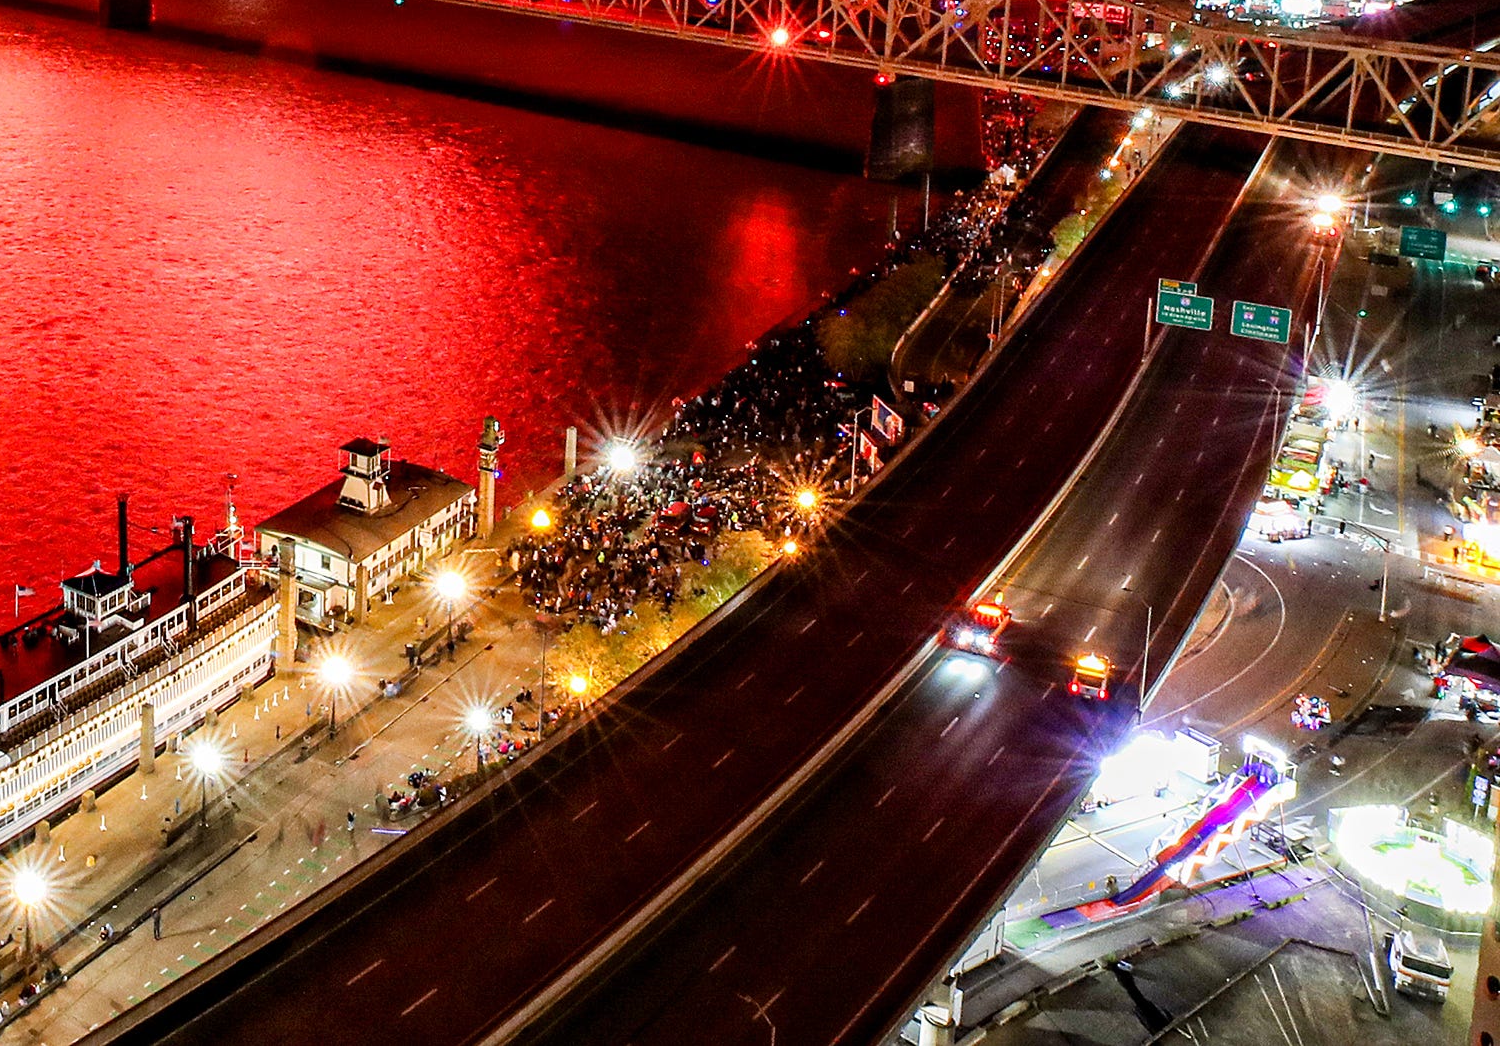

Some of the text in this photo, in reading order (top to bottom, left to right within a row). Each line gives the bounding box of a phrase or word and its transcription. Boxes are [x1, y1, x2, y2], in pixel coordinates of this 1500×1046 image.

[1163, 304, 1206, 317] Nashville
[1240, 327, 1280, 340] Cincinnati
[1241, 321, 1280, 333] Lexington
